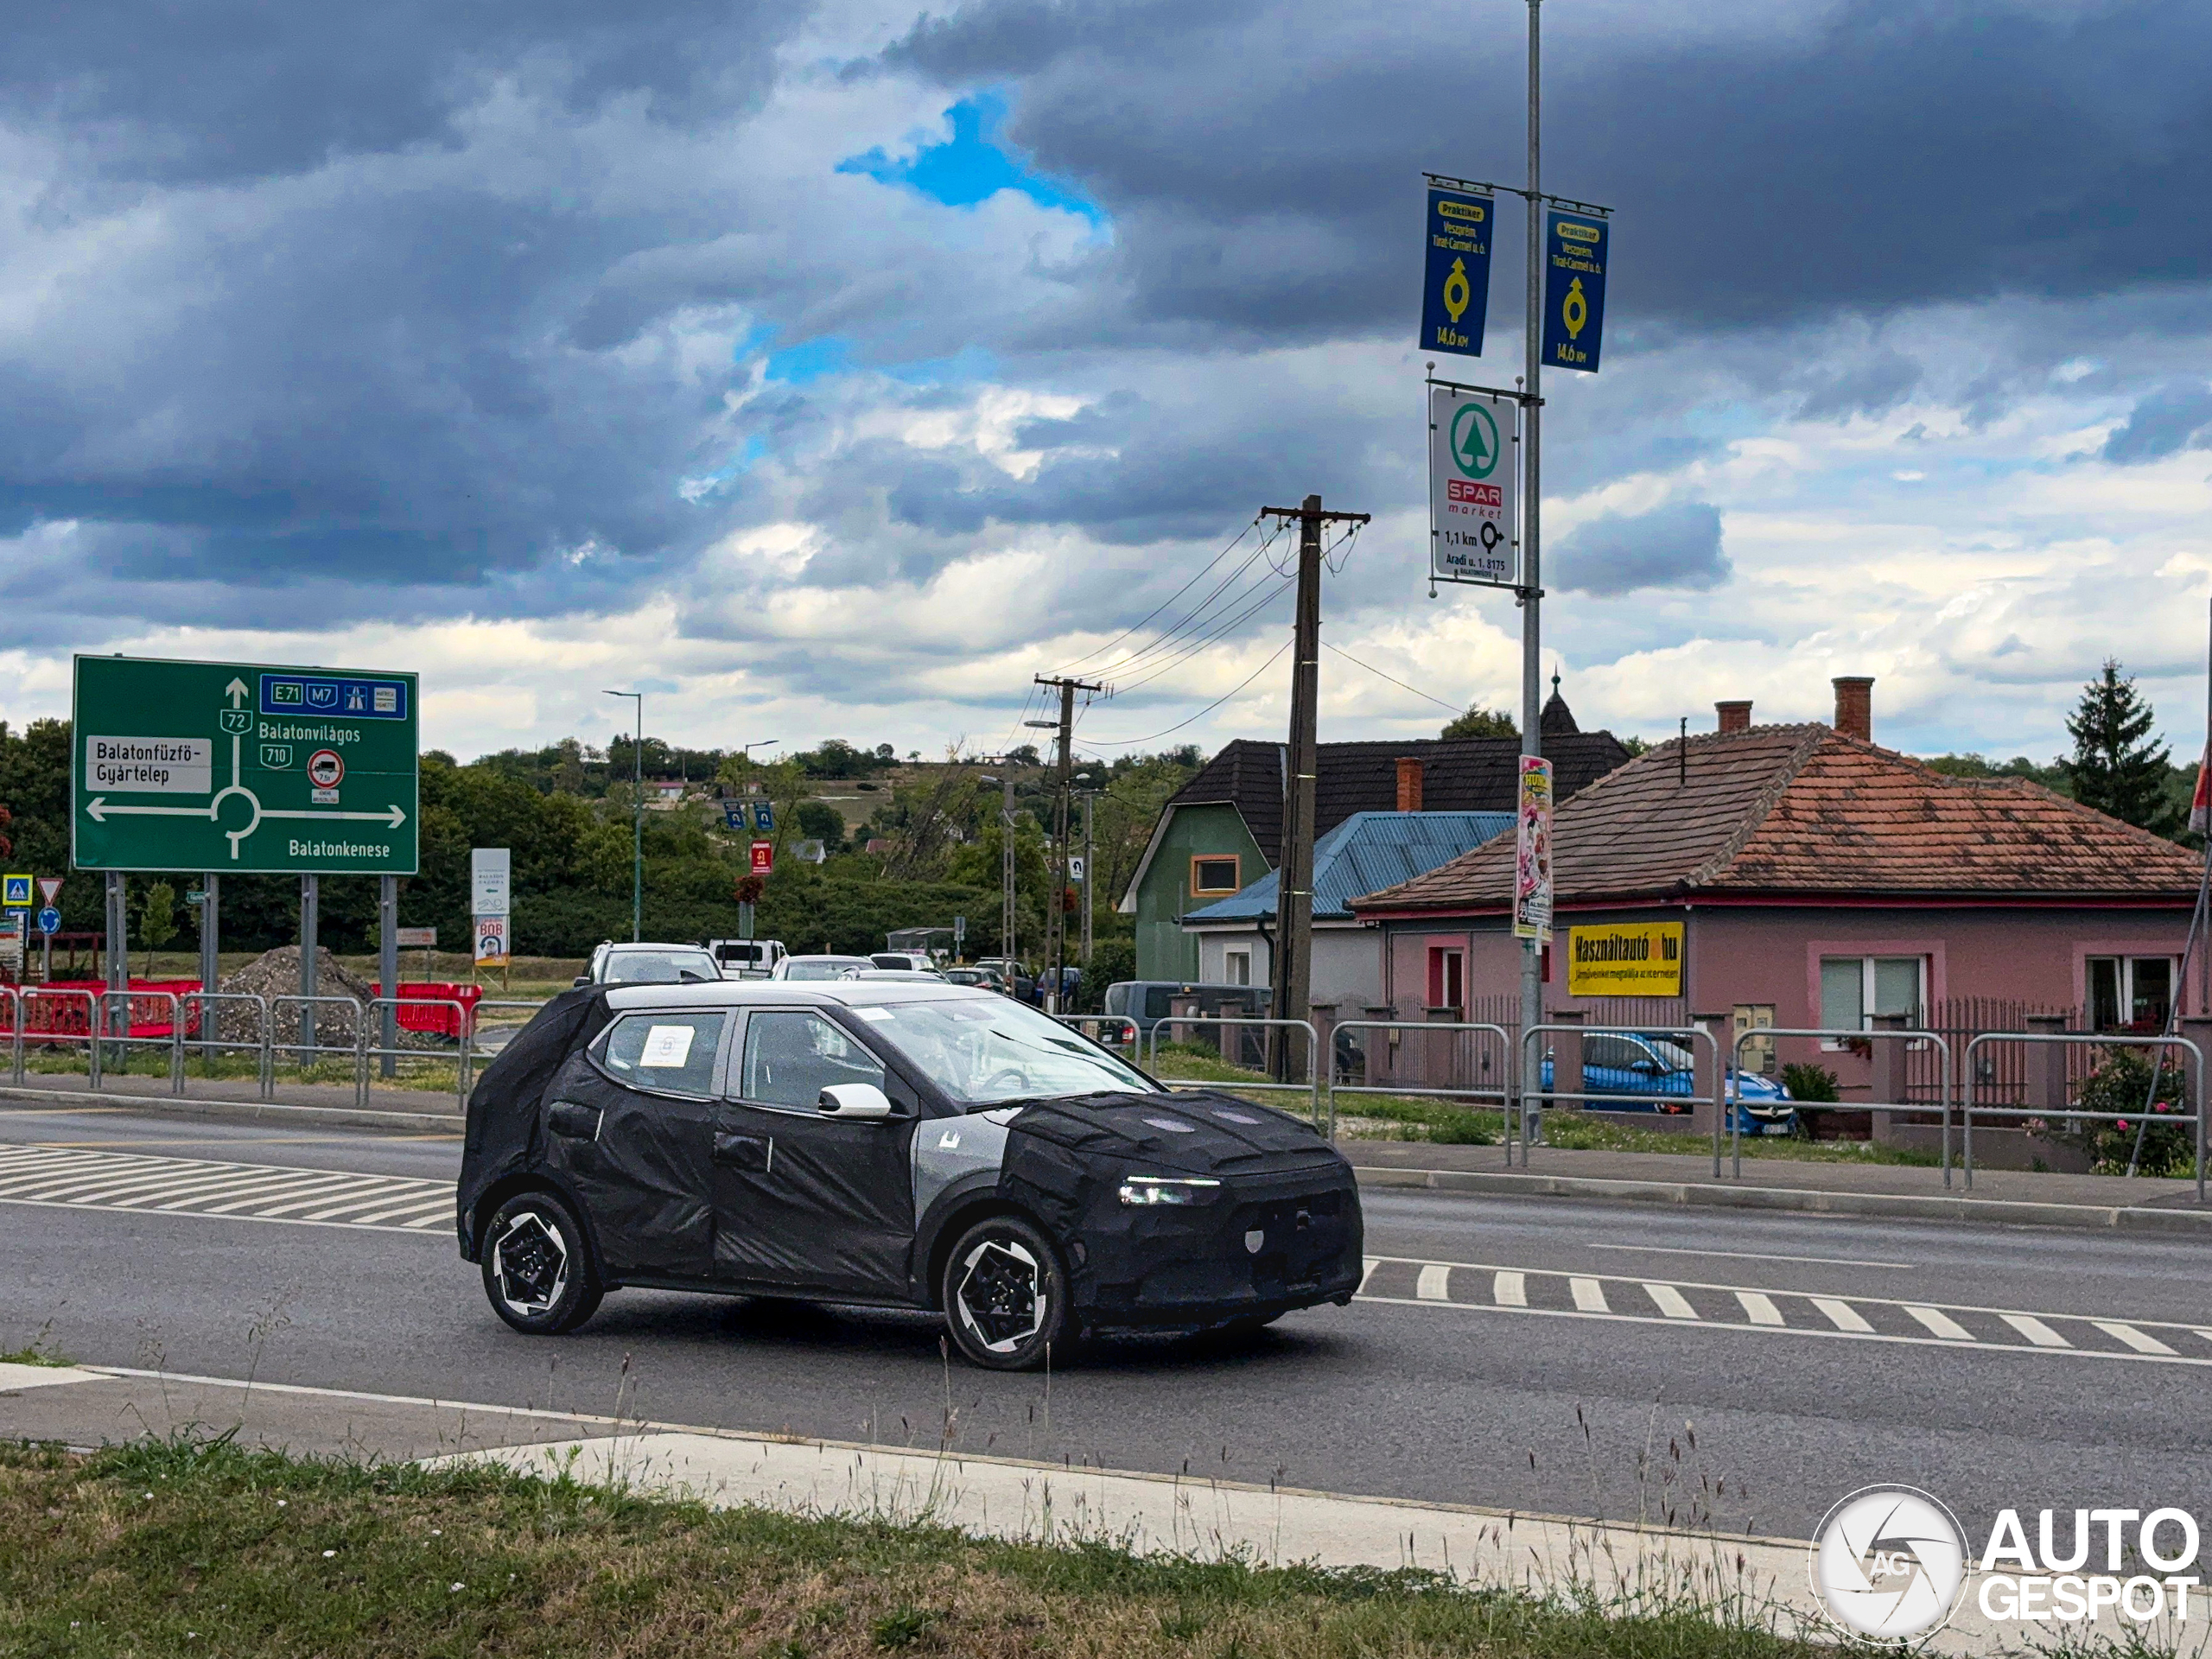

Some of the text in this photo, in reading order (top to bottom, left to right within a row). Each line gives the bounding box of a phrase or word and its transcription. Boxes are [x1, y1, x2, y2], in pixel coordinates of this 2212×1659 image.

[1442, 203, 1481, 219] Praktiker
[1561, 225, 1597, 240] Praktiker
[1437, 326, 1456, 347] 14,6
[1557, 343, 1575, 362] 14,6
[1449, 483, 1499, 504] SPAR
[1448, 505, 1502, 519] market
[1445, 530, 1478, 547] 1,1 km
[1446, 553, 1505, 571] Aradi u. 1. 8175
[312, 688, 332, 702] M7
[228, 715, 245, 728] 72
[259, 722, 360, 746] Balatonvilágos
[267, 748, 286, 762] 710
[97, 764, 169, 785] Gyártelep
[289, 839, 390, 858] Balatonkenese
[480, 924, 503, 936] BOB
